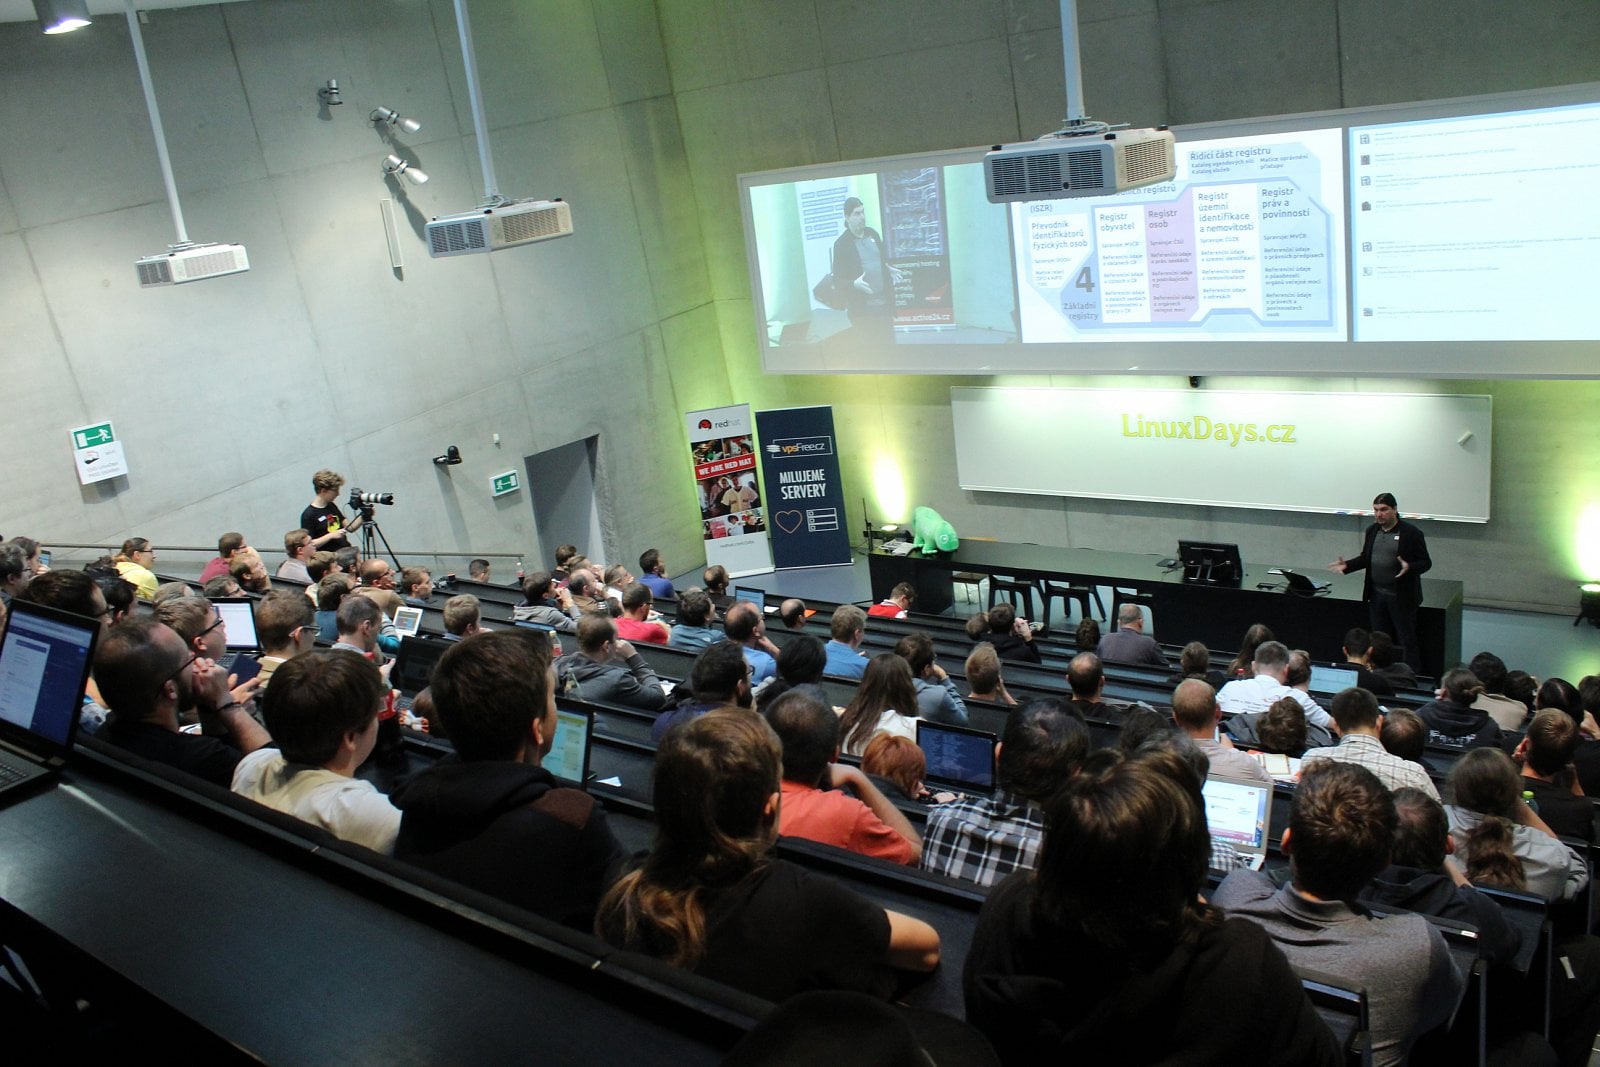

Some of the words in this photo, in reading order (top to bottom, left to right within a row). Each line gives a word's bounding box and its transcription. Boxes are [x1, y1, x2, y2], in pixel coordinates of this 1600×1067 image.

[1235, 147, 1271, 158] registru
[1143, 183, 1176, 195] registrů
[1261, 187, 1294, 198] Registr
[1198, 192, 1229, 202] Registr
[1030, 203, 1052, 213] (ISZR)
[1199, 202, 1229, 211] územní
[1262, 198, 1281, 209] práv
[1100, 212, 1128, 222] Registr
[1148, 208, 1178, 219] Registr
[1199, 212, 1250, 222] identifikace
[1263, 208, 1310, 220] povinností
[1101, 221, 1136, 232] obyvatel
[1149, 219, 1168, 229] osob
[1206, 222, 1254, 232] nemovitostí
[1070, 239, 1088, 248] osob
[1075, 266, 1095, 292] 4
[1064, 302, 1096, 310] Základní
[1069, 311, 1098, 321] registry
[1120, 413, 1297, 447] LinuxDays.cz
[698, 467, 710, 476] WE
[710, 464, 725, 473] ARE
[724, 461, 738, 469] RED
[738, 458, 752, 466] HAT
[779, 468, 826, 484] MILUJEME
[780, 483, 826, 500] SERVERY
